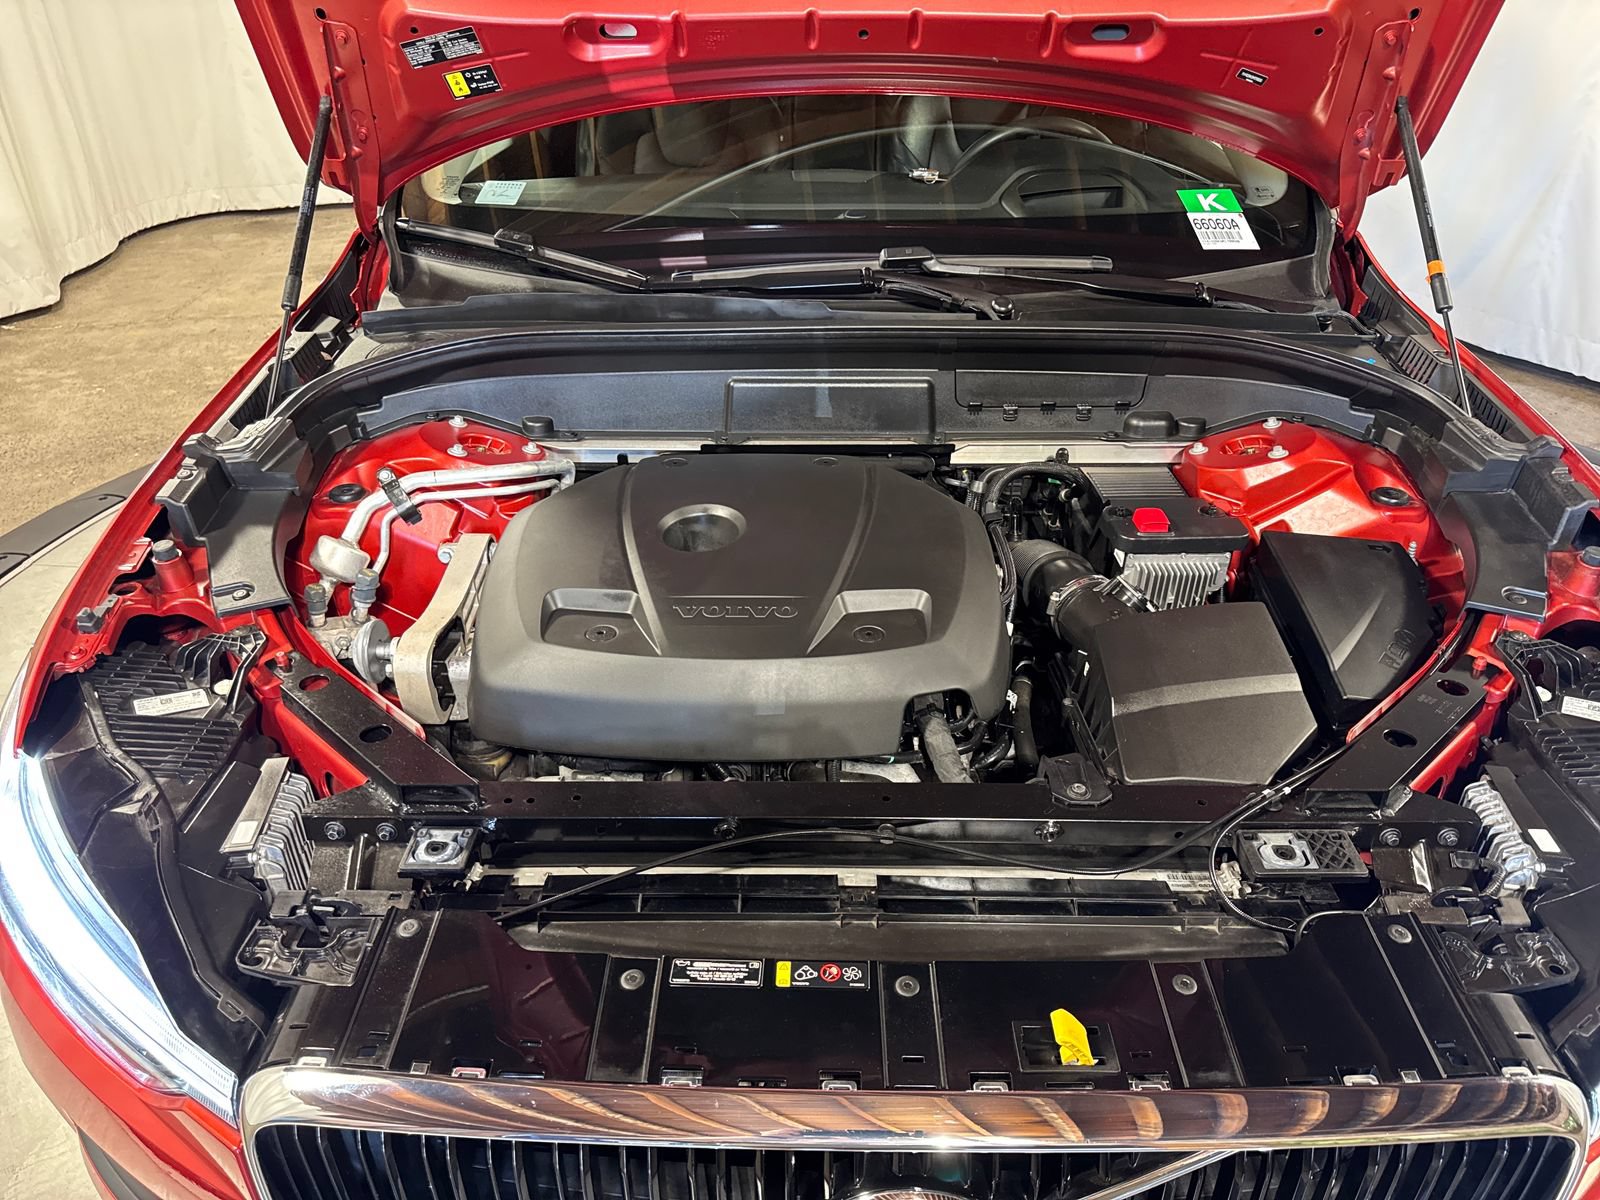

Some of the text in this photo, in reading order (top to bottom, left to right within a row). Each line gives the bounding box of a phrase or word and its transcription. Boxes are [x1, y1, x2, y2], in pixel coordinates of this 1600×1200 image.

[1196, 193, 1228, 211] K
[1192, 218, 1240, 230] 66060A
[672, 605, 799, 619] VOLVO
